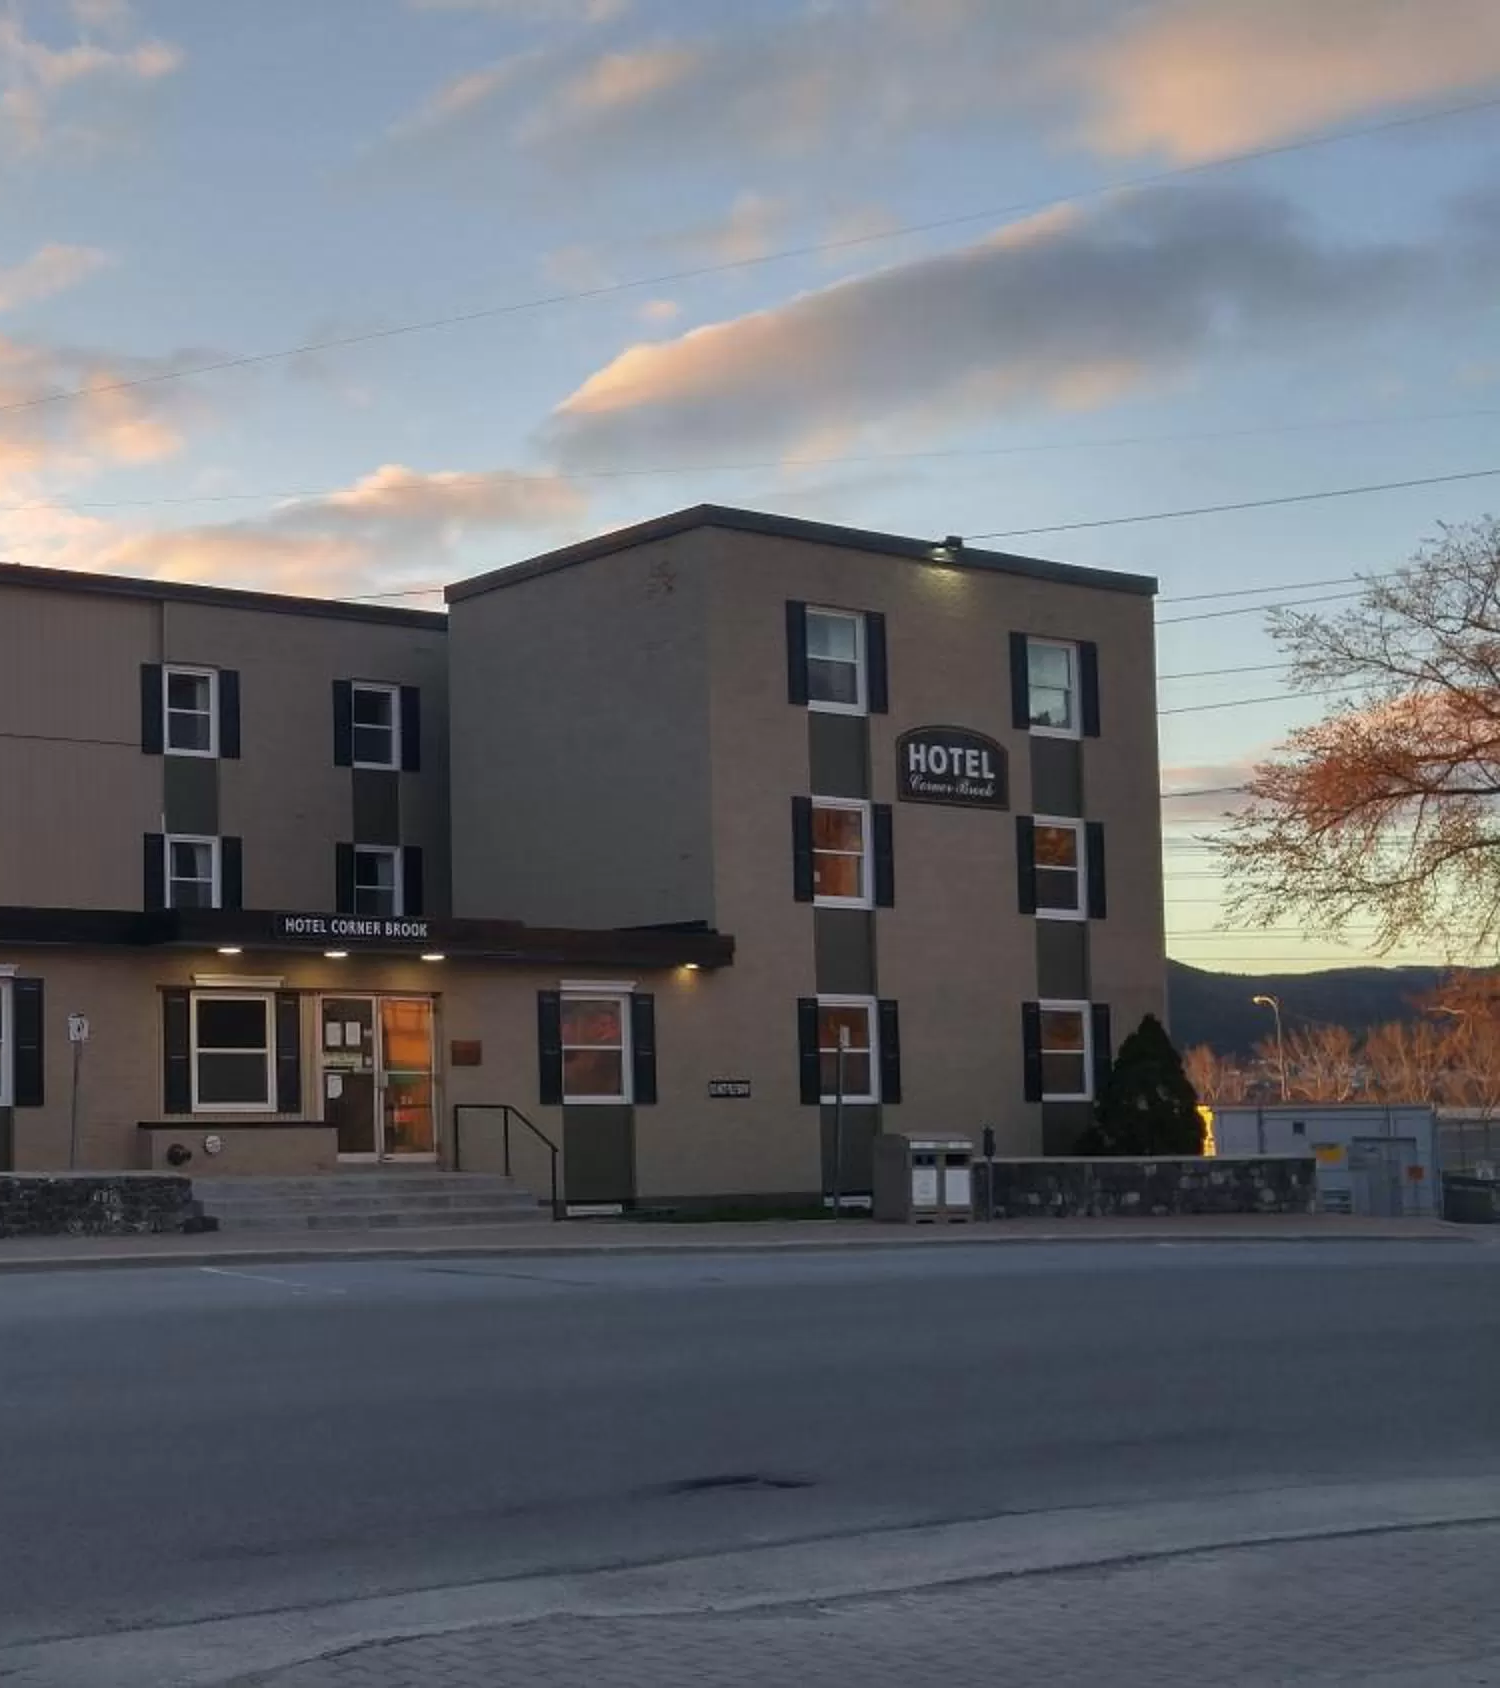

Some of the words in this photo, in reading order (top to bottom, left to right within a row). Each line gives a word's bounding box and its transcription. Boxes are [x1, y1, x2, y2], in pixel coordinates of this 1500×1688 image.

[908, 743, 995, 779] HOTEL
[909, 774, 952, 793] Corner
[955, 778, 995, 797] Brook
[285, 917, 327, 933] HOTEL
[331, 919, 381, 935] CORNER
[385, 921, 428, 937] BROOK
